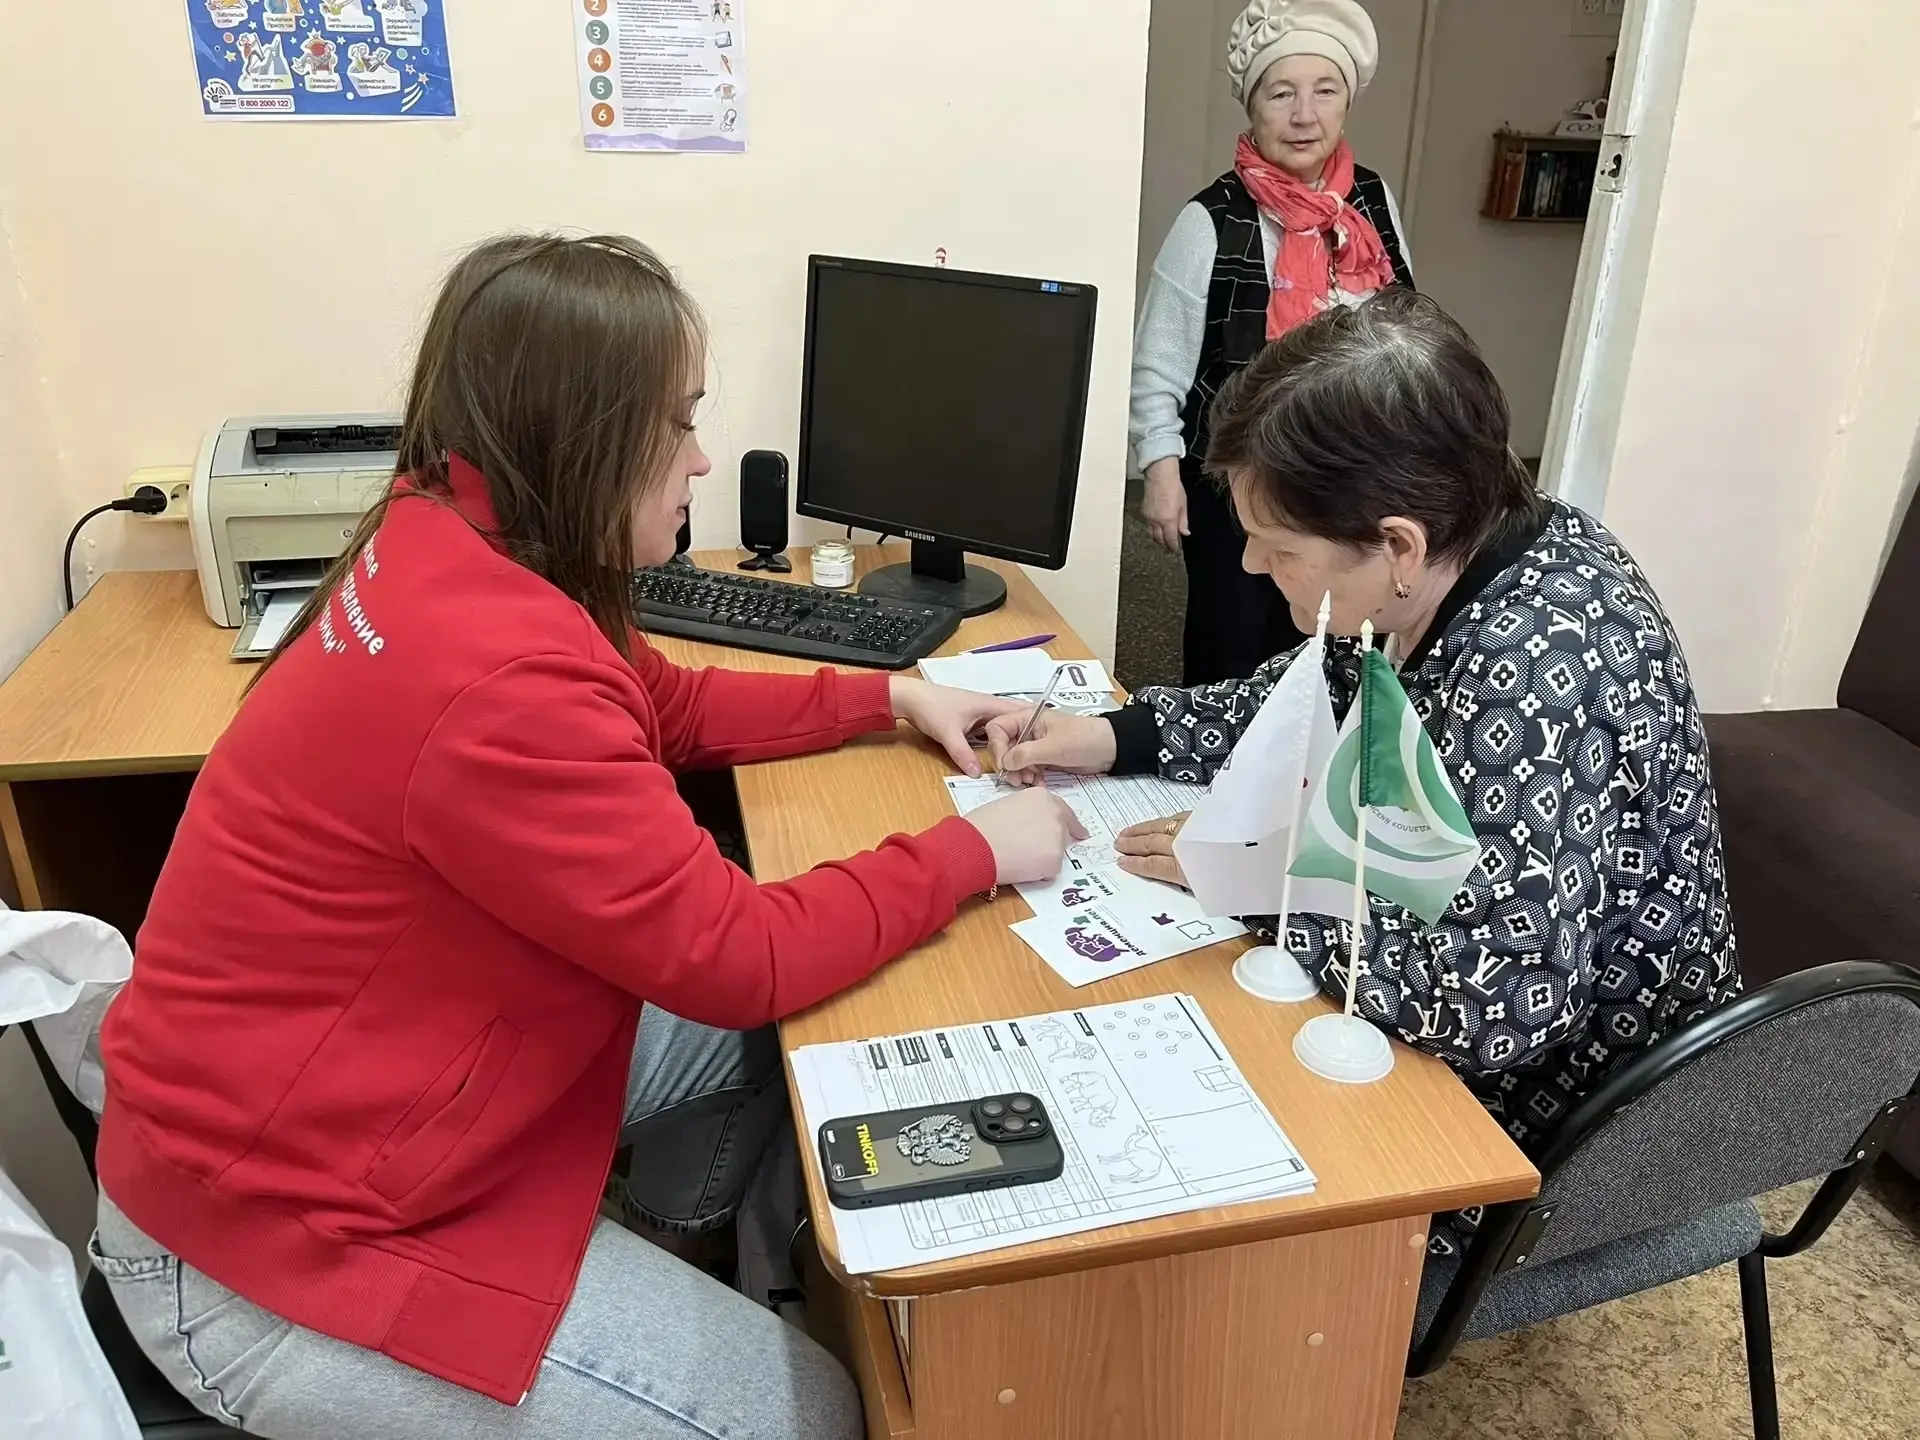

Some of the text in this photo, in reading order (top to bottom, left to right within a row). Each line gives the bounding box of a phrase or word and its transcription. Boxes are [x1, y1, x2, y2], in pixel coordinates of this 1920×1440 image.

[591, 0, 599, 11] 2
[592, 26, 601, 39] 3
[594, 54, 603, 67] 4
[596, 82, 605, 94] 5
[598, 109, 607, 121] 6
[904, 529, 935, 543] SAMSUNG
[856, 1123, 879, 1176] TINKOFF
